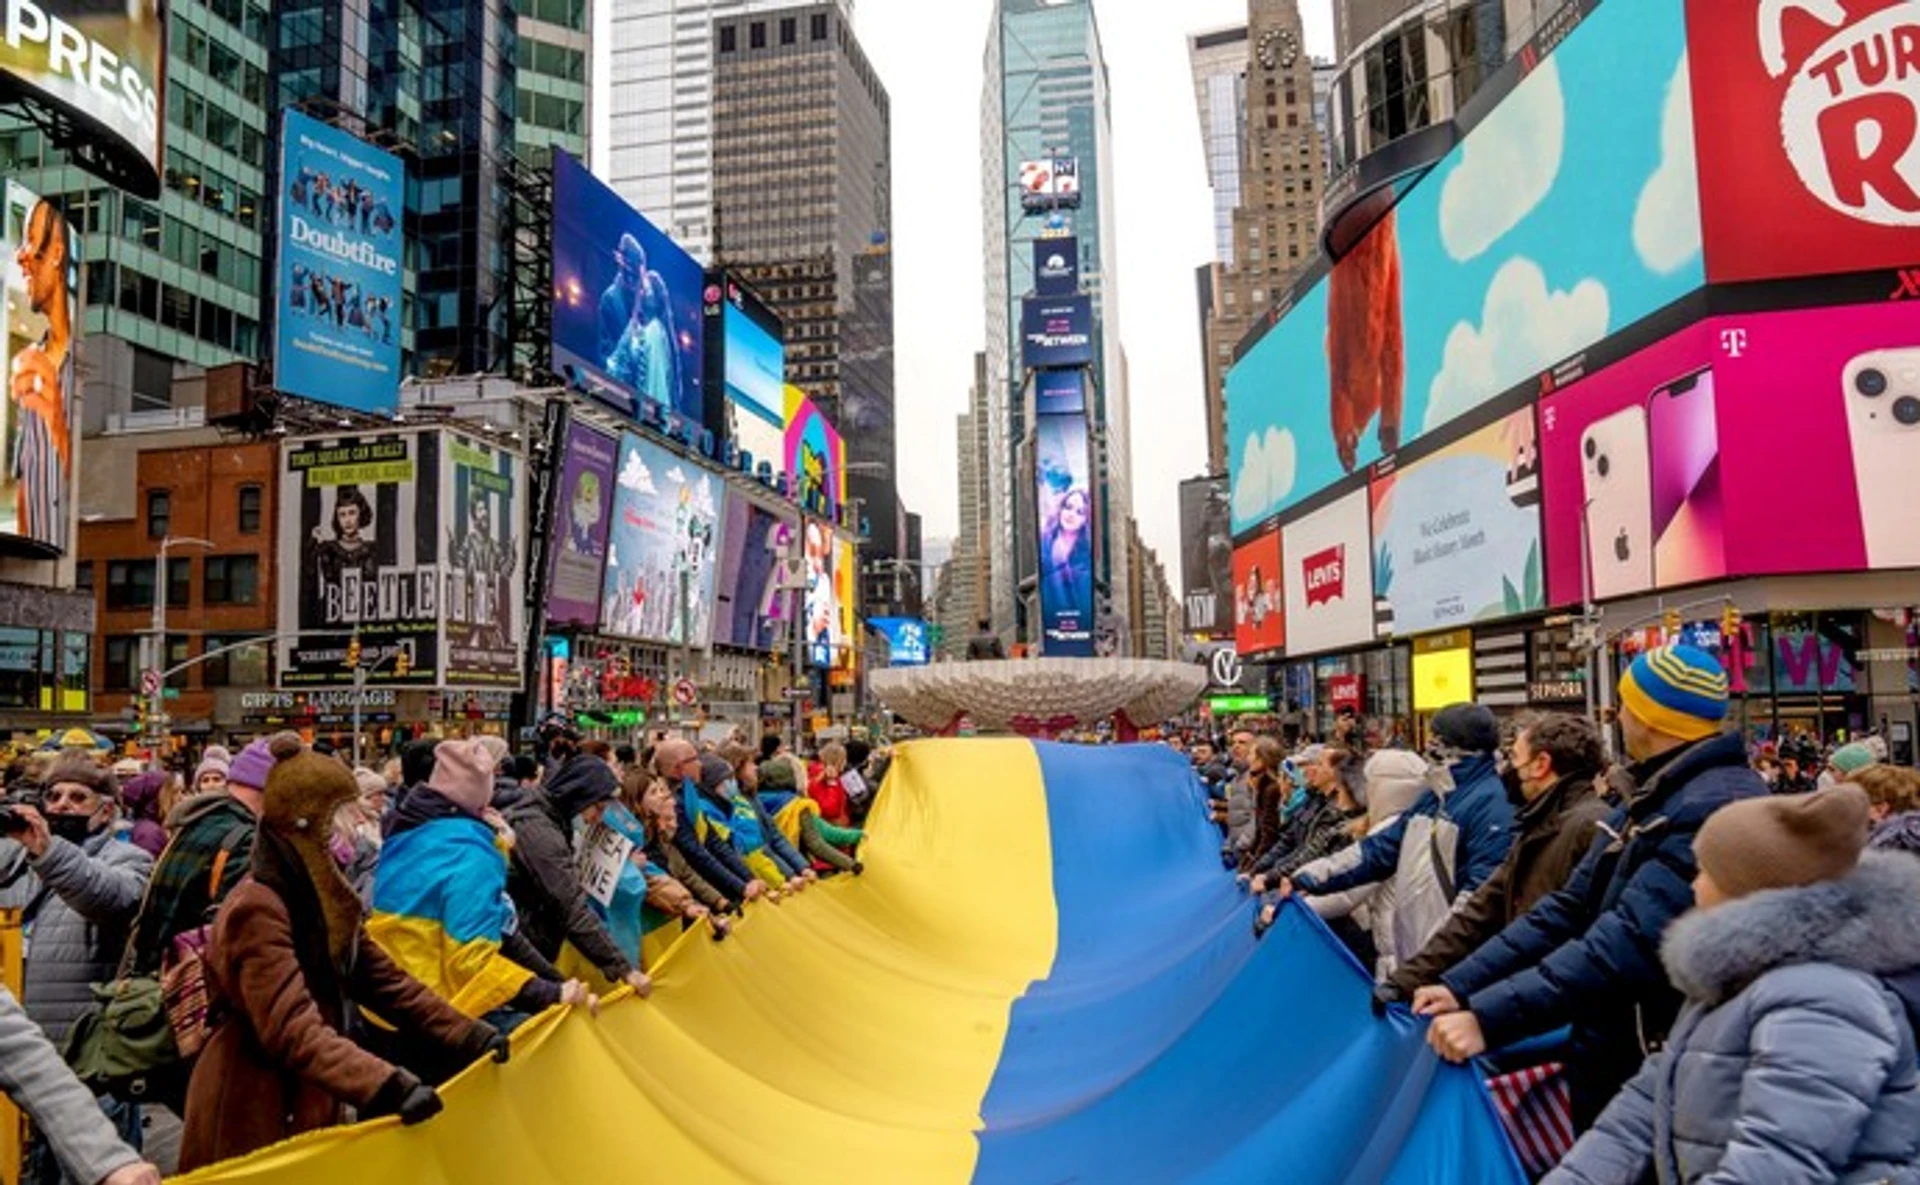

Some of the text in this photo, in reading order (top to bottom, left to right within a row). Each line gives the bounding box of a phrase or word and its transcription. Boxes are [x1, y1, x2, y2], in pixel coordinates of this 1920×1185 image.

[290, 215, 396, 276] Doubtfire
[241, 689, 397, 708] GIFTS LUGGAGE
[1530, 682, 1583, 699] SEPHORA
